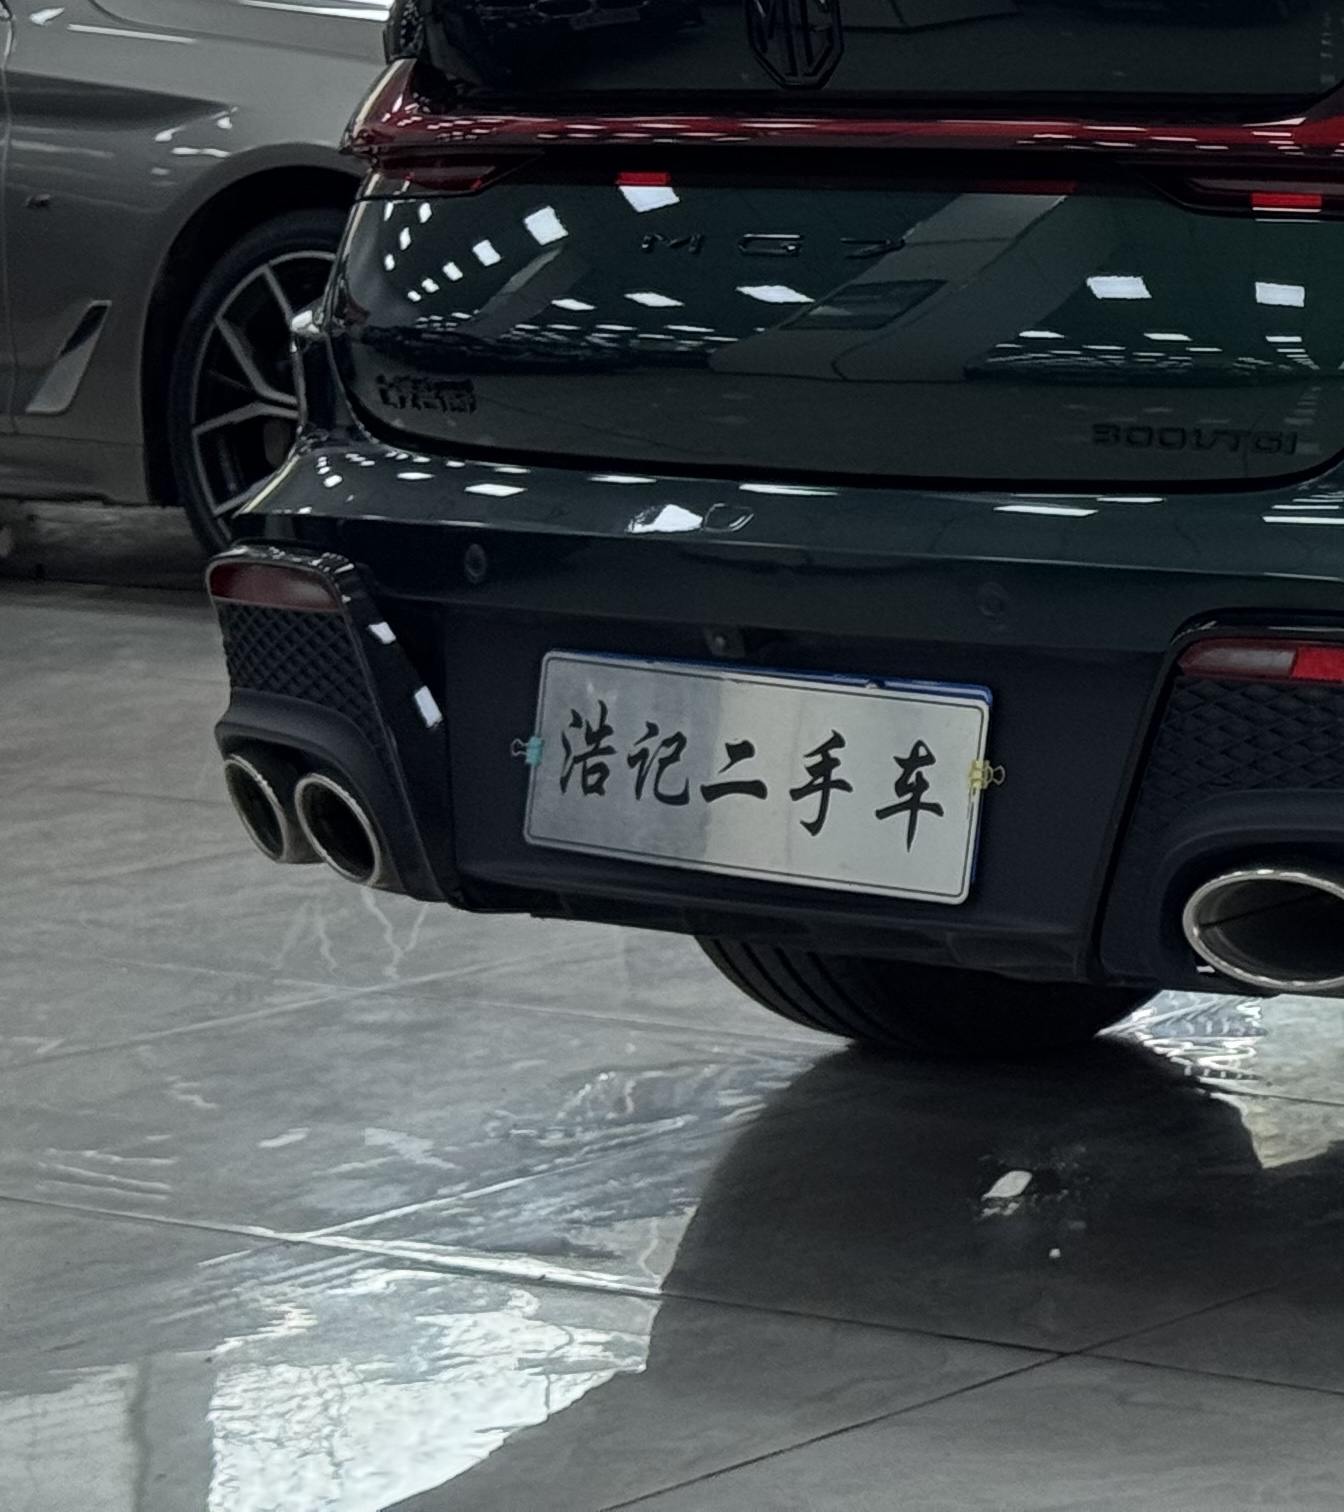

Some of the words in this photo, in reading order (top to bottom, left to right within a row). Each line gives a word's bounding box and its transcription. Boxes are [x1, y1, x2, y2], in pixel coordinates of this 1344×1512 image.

[560, 699, 944, 852] 浩记二手车
